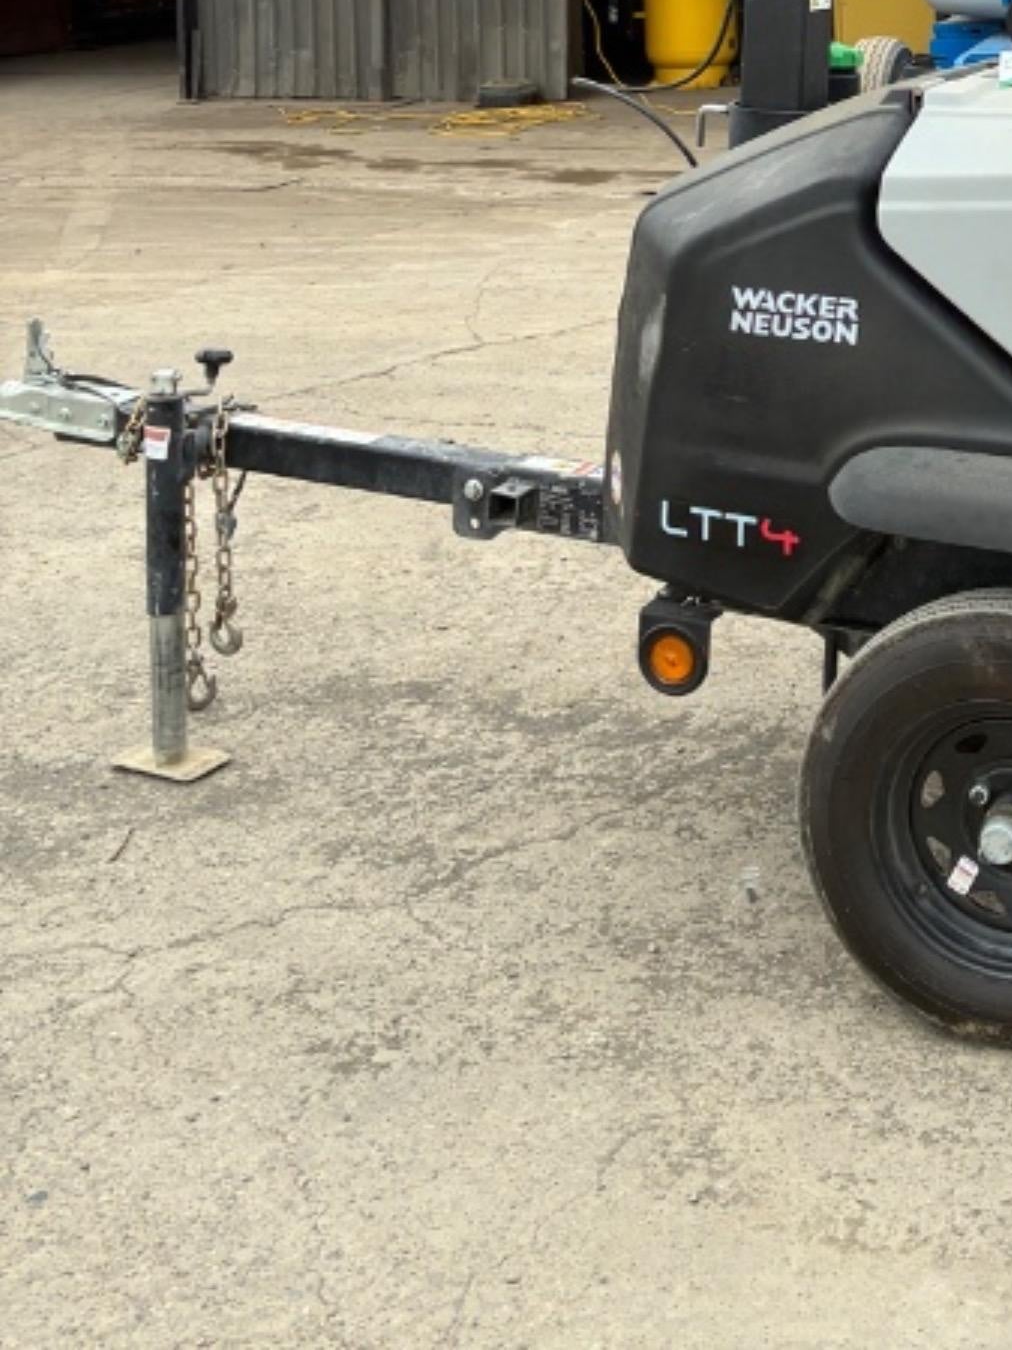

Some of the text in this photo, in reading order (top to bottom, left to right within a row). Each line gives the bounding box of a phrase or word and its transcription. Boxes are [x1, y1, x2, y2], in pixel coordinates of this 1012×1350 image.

[731, 284, 859, 322] WACKER
[731, 310, 859, 346] NEUSON
[661, 500, 800, 555] LTT4
